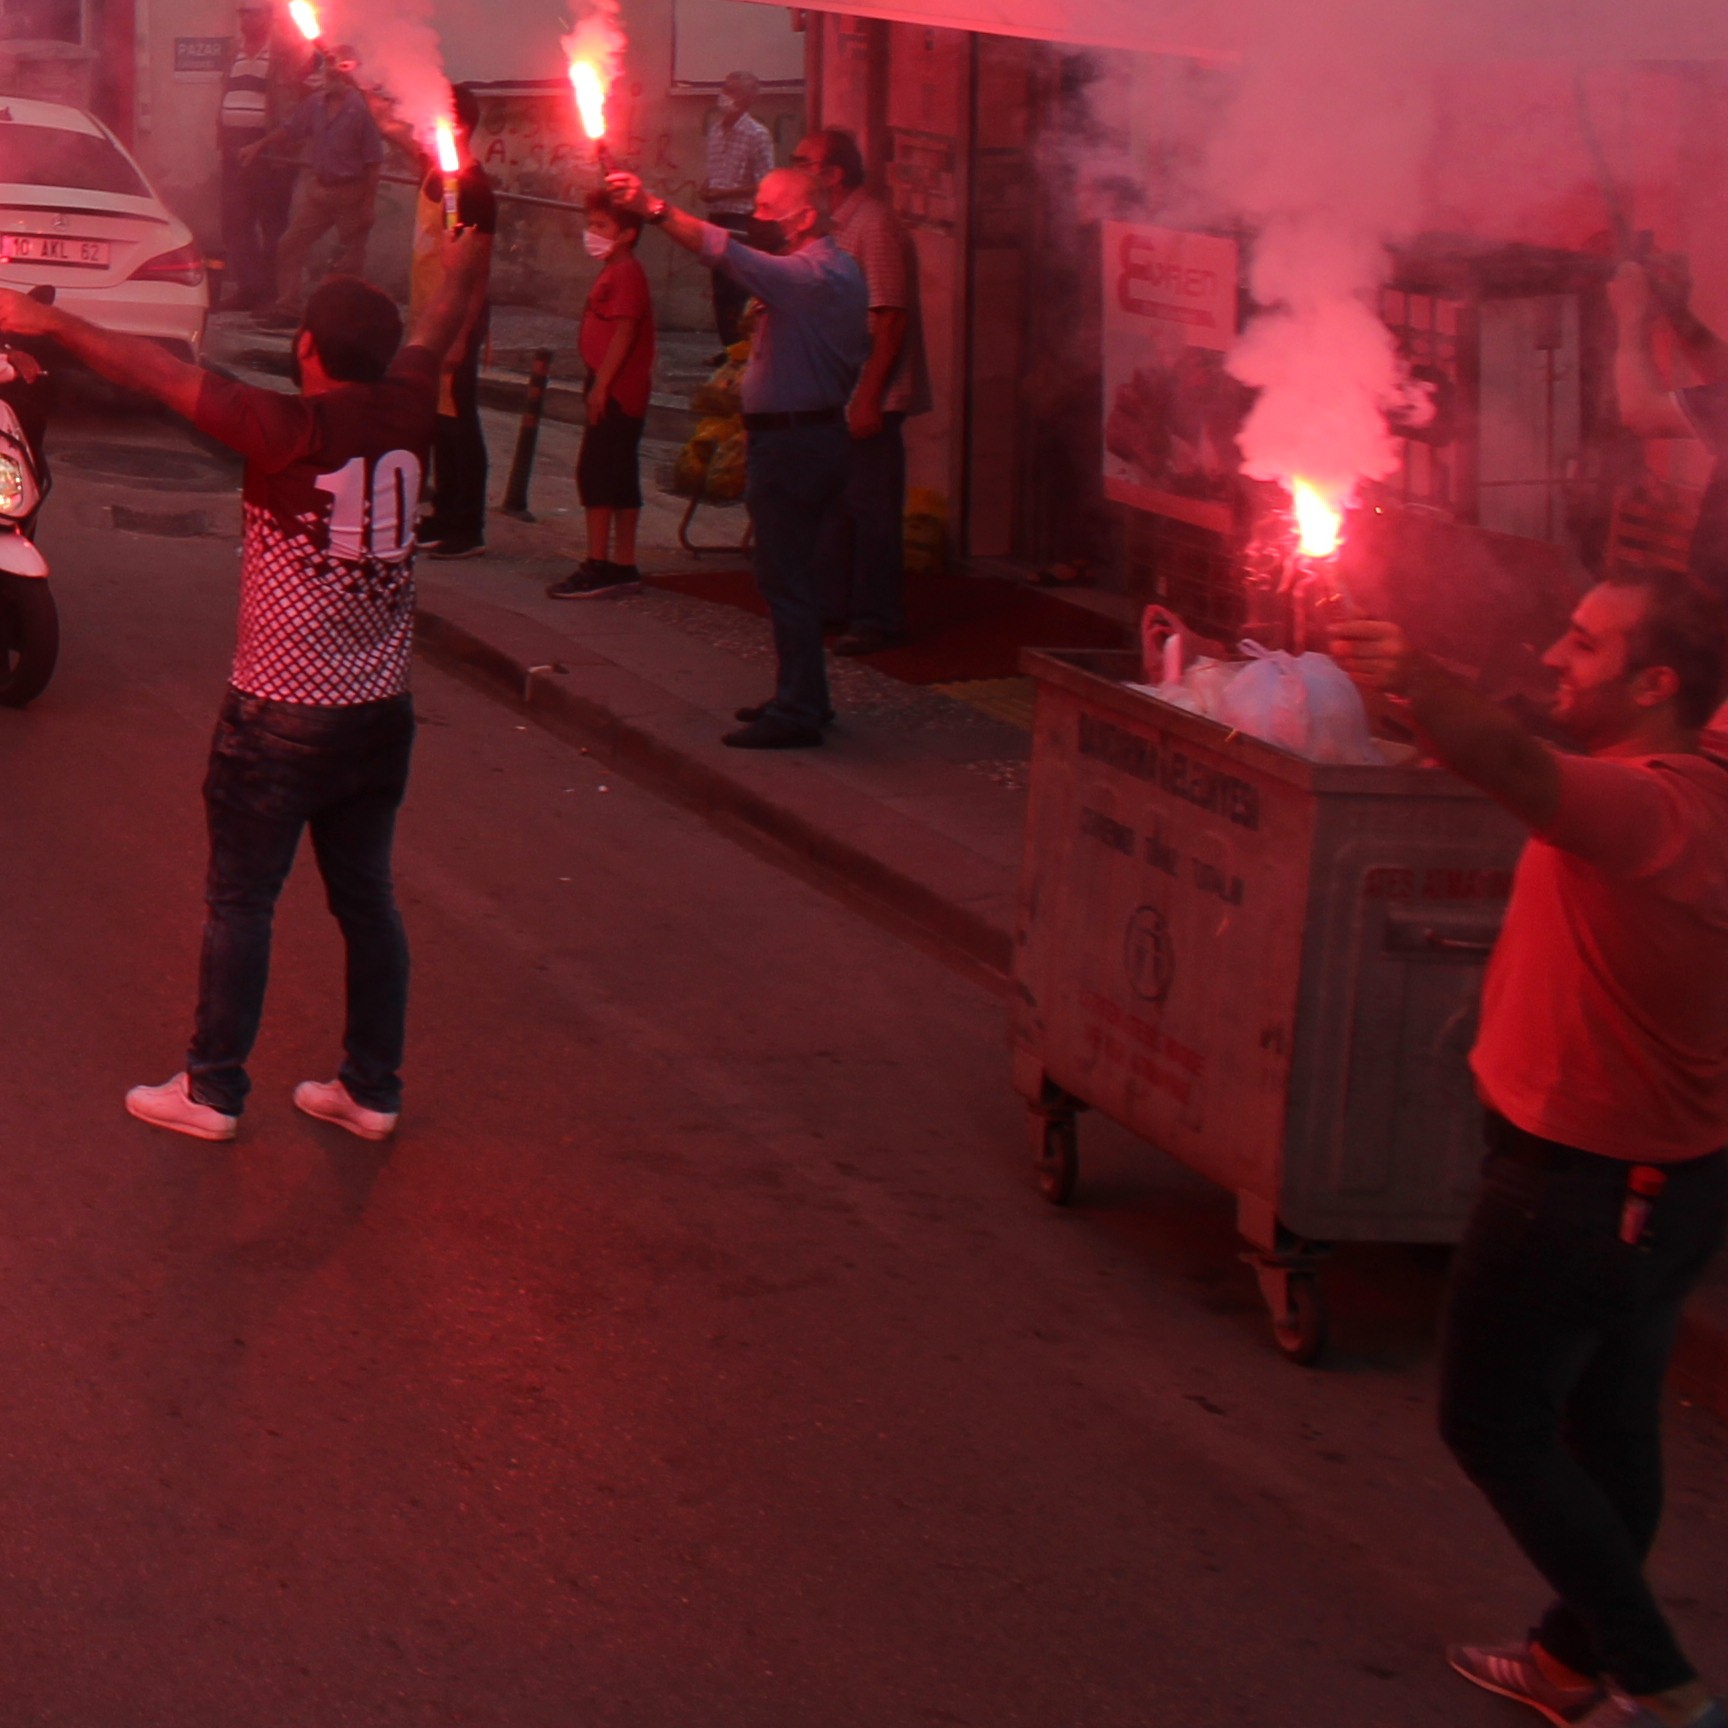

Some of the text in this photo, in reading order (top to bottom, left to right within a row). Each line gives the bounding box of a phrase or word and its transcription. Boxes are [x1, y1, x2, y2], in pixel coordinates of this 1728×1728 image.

[178, 43, 221, 56] PAZAR
[14, 238, 100, 261] 10 AKL 62
[314, 449, 422, 563] 10
